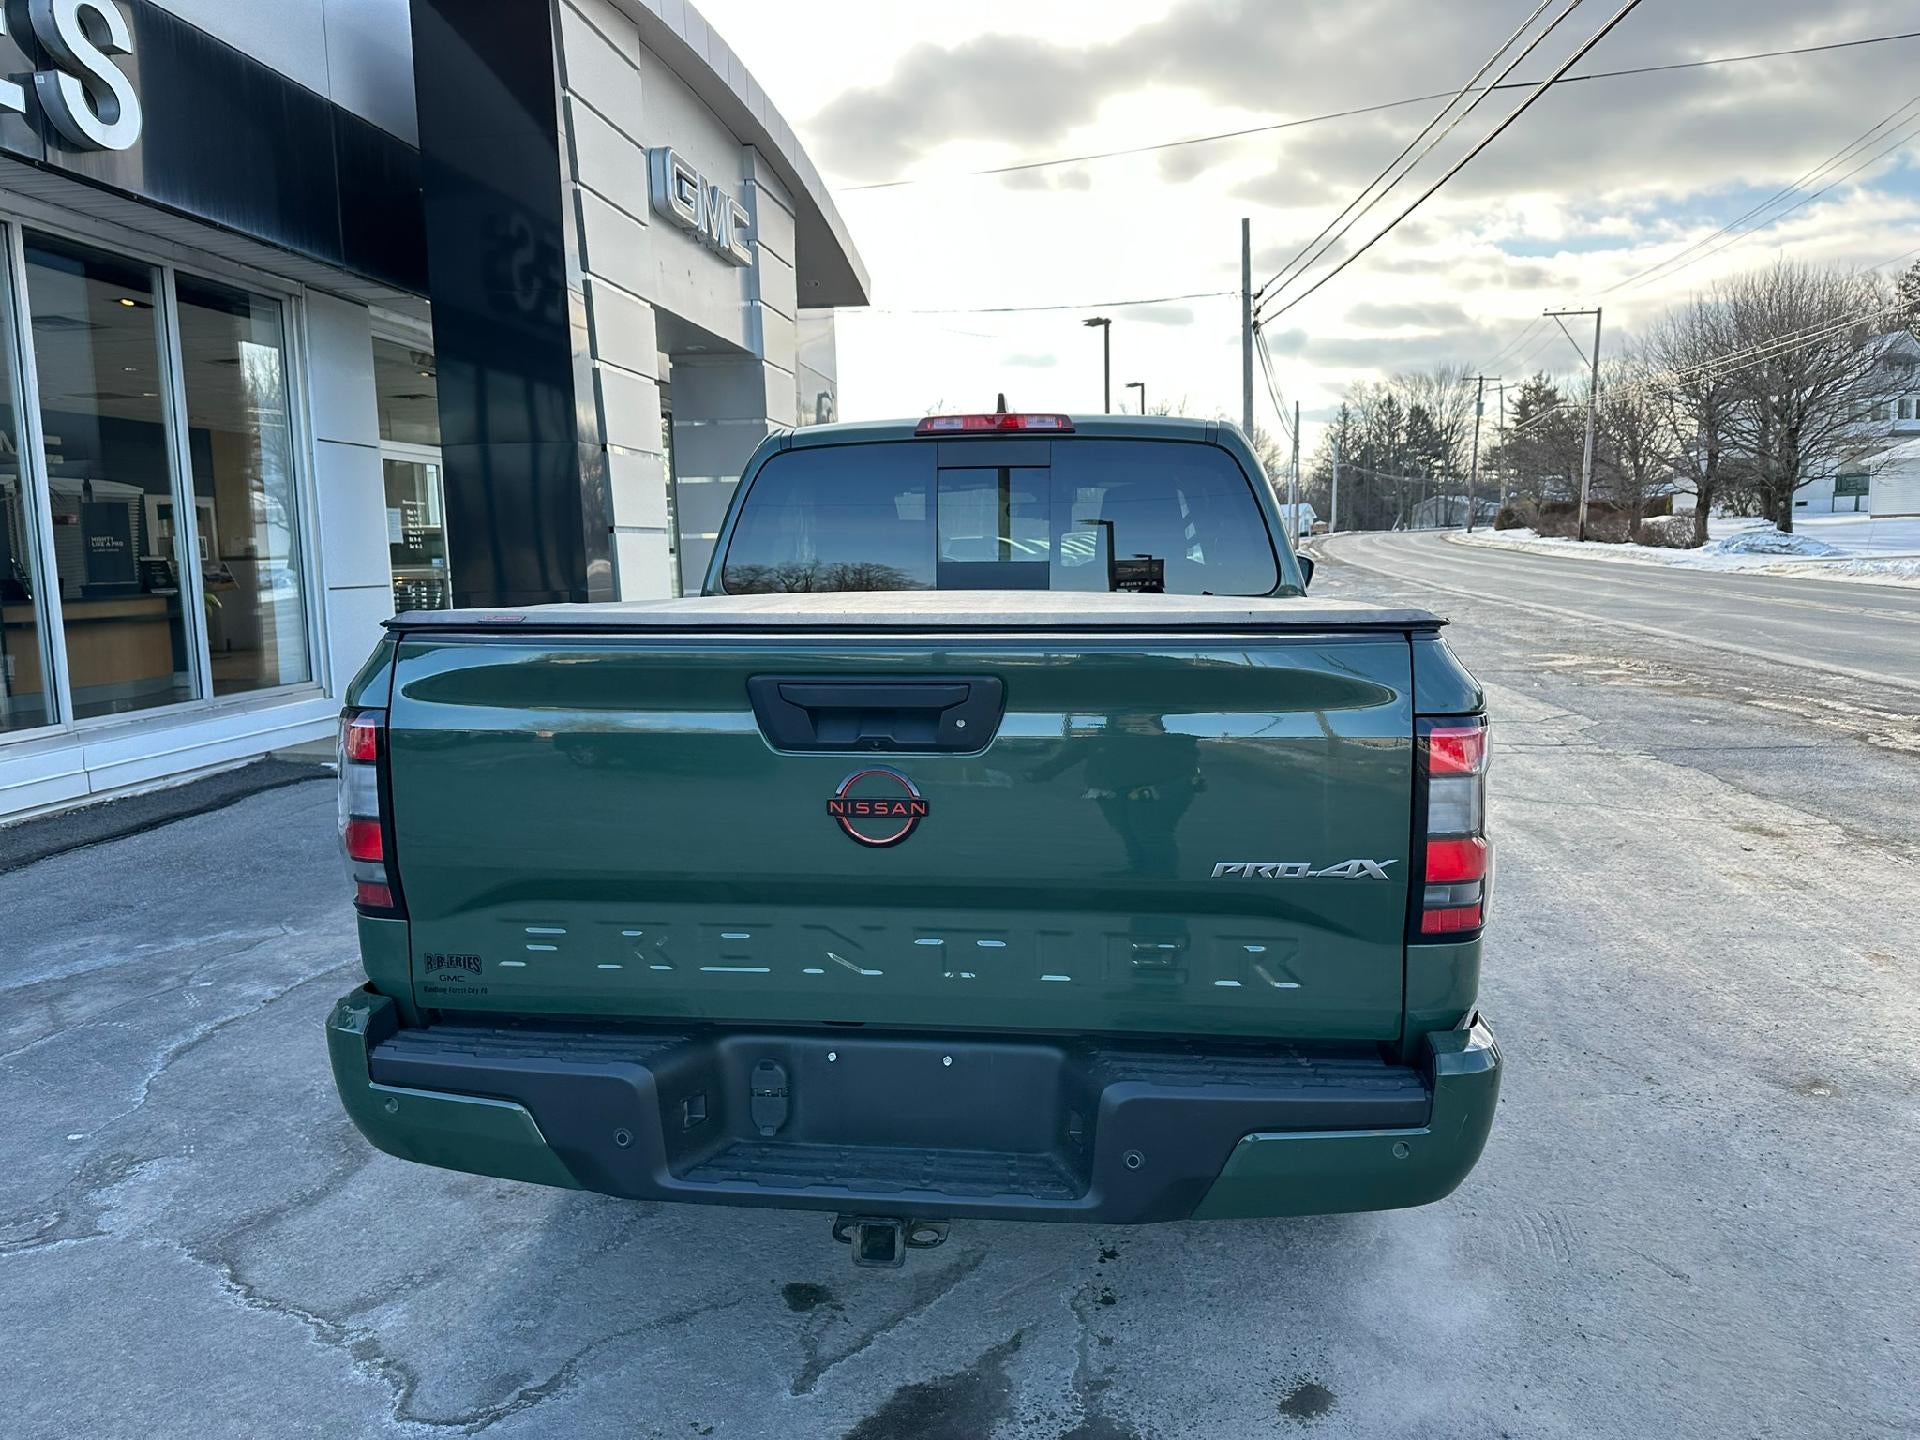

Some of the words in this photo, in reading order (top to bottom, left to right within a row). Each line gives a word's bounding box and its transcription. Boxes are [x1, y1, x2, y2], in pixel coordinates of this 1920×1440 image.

[0, 0, 143, 151] S
[649, 147, 752, 267] GMC
[829, 801, 927, 815] NISSAN
[1211, 859, 1399, 880] PRO-4X
[440, 974, 465, 983] GMC
